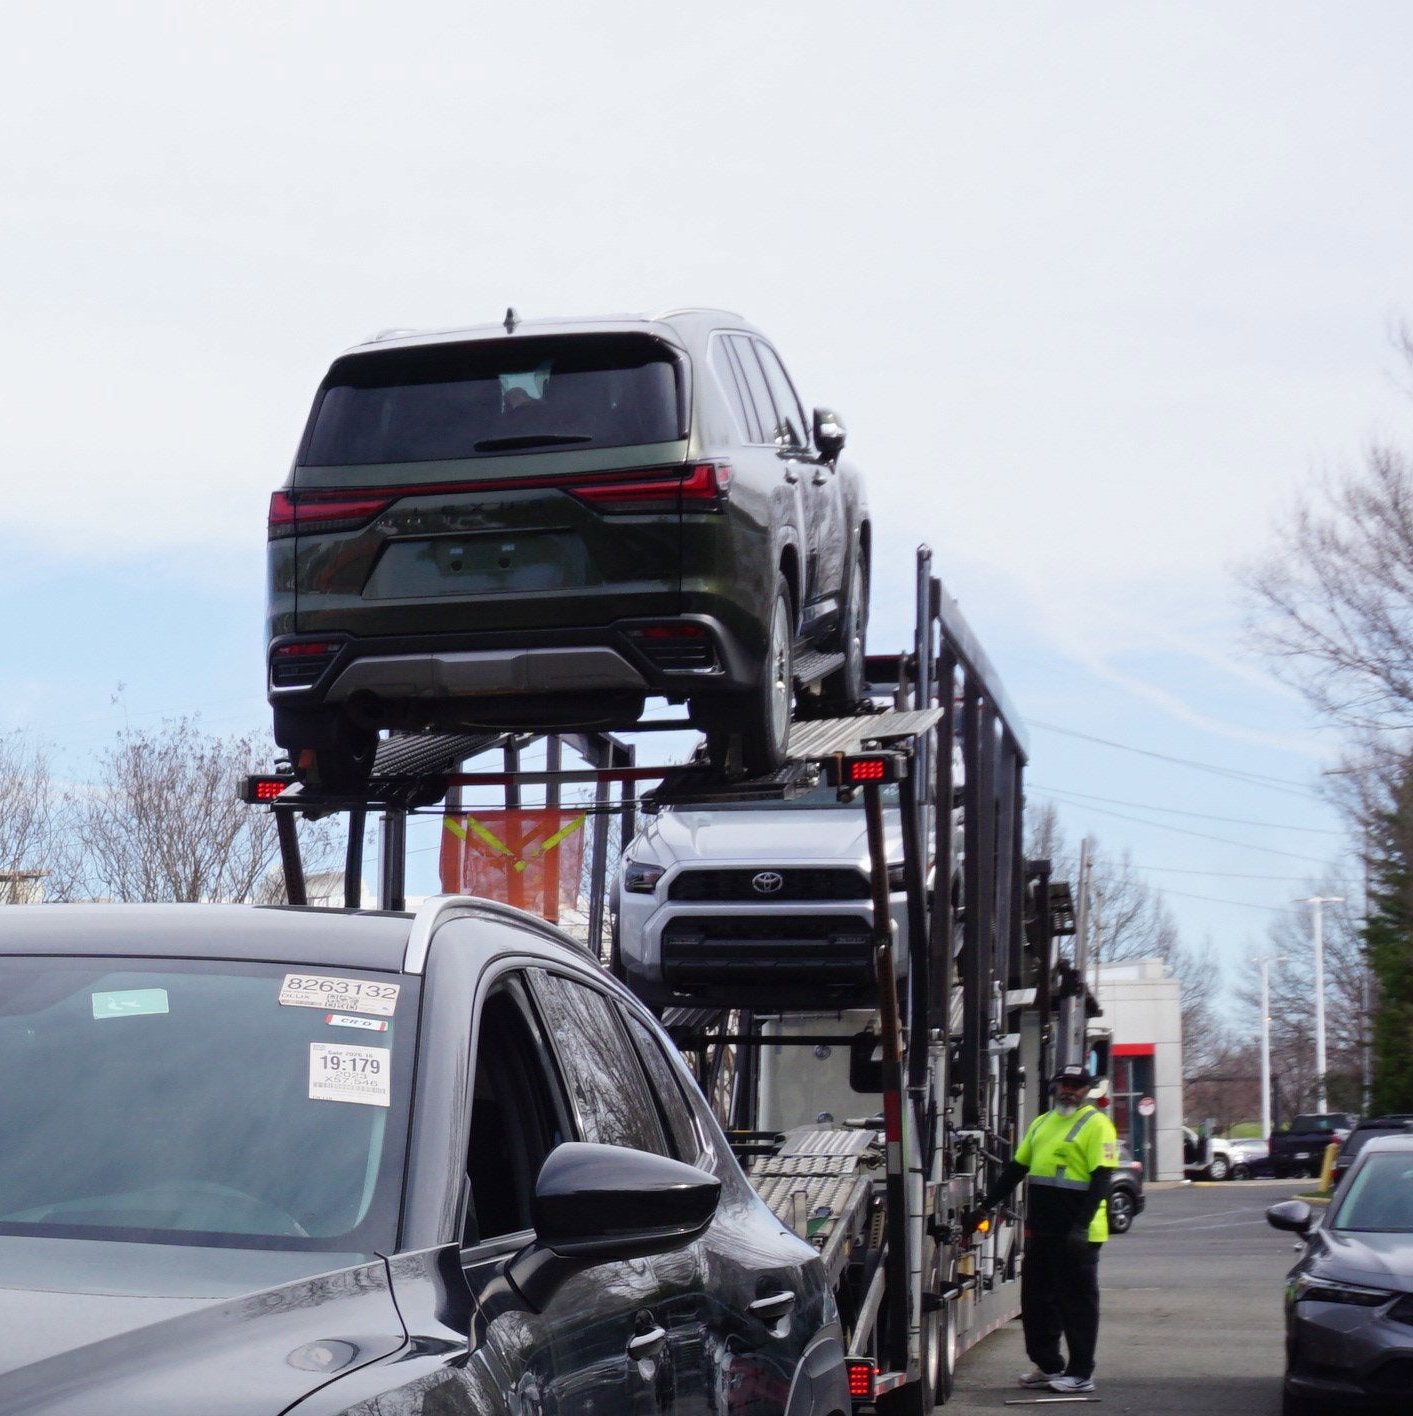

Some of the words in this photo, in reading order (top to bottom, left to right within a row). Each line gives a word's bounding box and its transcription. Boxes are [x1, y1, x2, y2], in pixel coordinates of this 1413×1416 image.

[287, 978, 397, 1000] 8263132
[320, 1055, 381, 1074] 19:179
[335, 1071, 368, 1079] 2023
